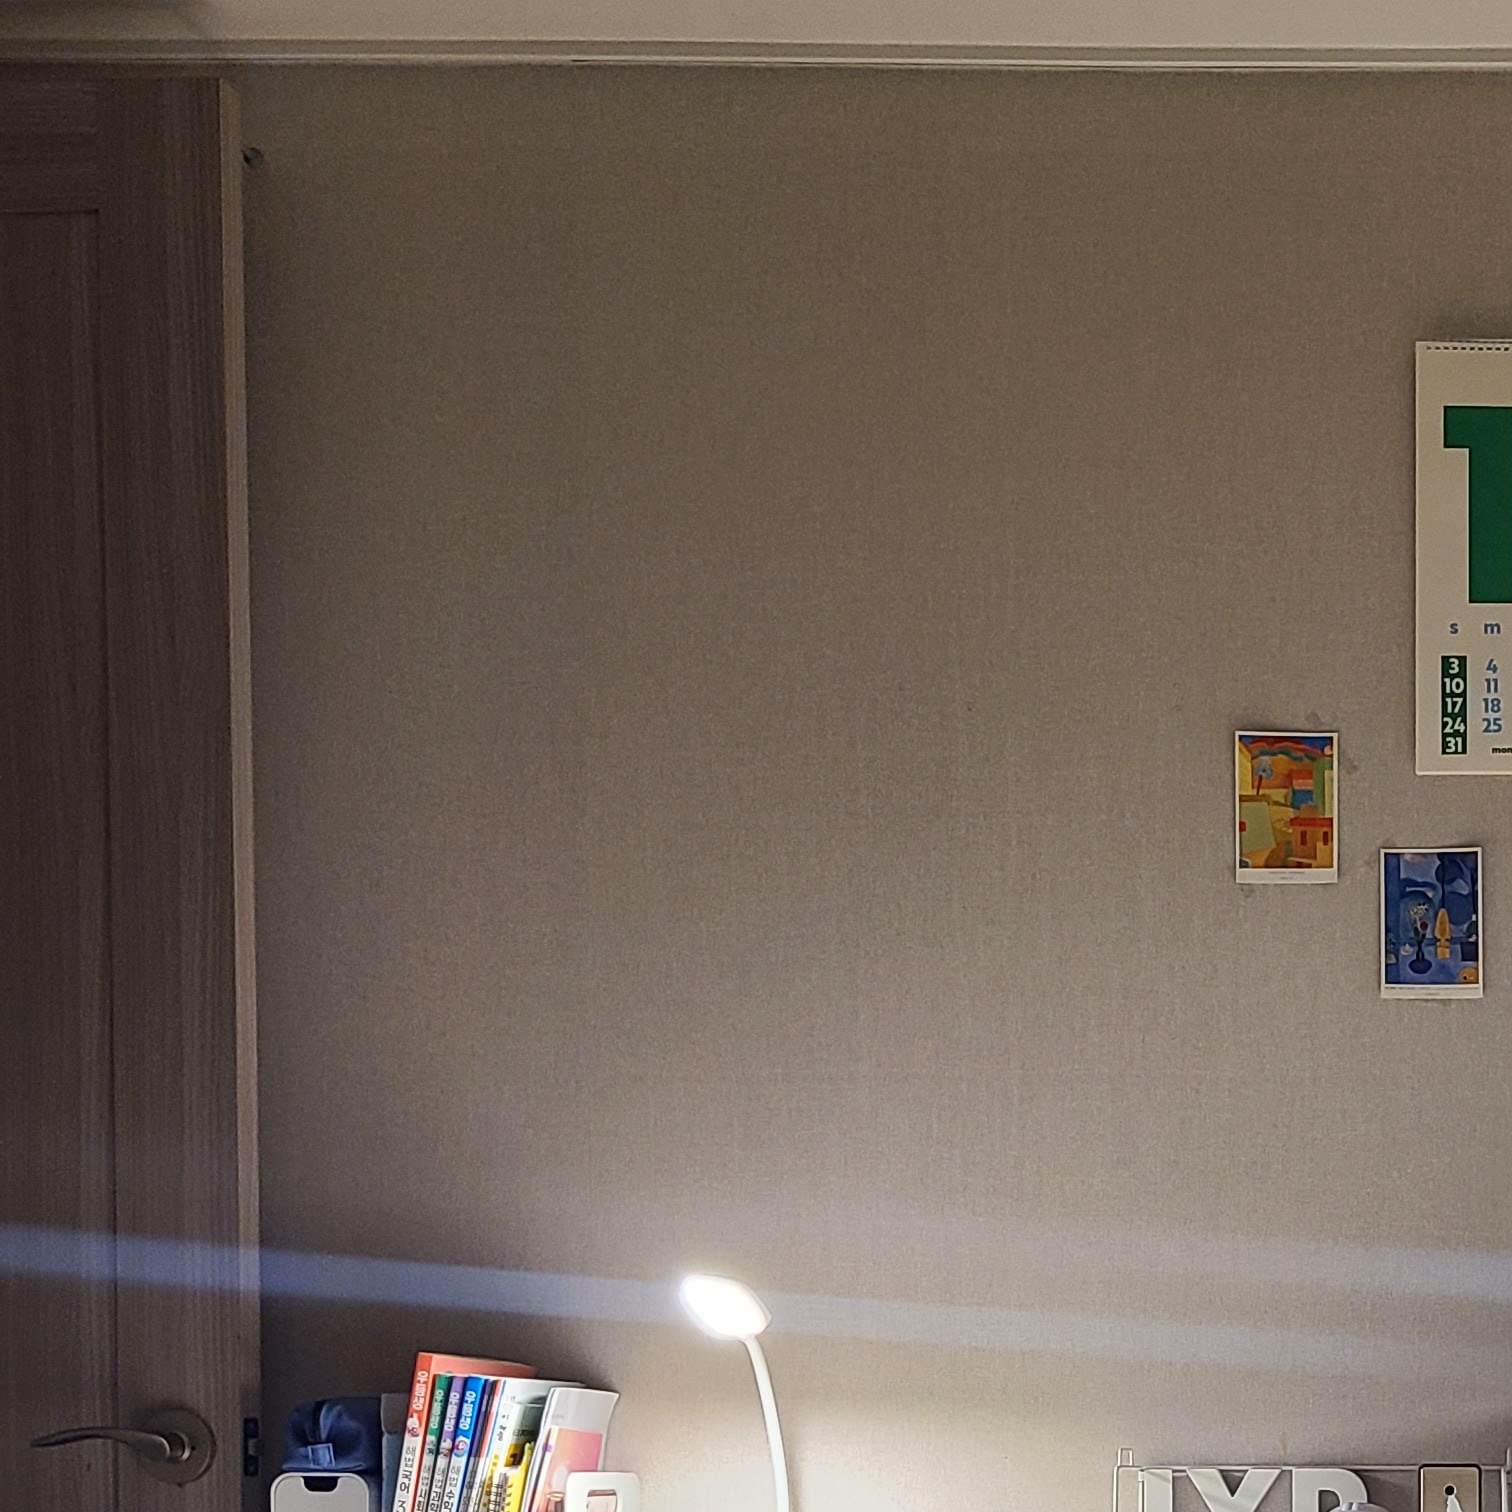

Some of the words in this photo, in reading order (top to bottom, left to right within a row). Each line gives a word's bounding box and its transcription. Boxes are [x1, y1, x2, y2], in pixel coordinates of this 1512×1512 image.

[1449, 623, 1458, 635] s
[1484, 623, 1501, 635] m
[1448, 658, 1460, 674] 3
[1486, 658, 1498, 674] 4
[1444, 677, 1464, 693] 10
[1485, 677, 1499, 693] 11
[1445, 697, 1463, 713] 17
[1483, 697, 1501, 713] 18
[1443, 717, 1465, 733] 24
[1482, 716, 1502, 733] 25
[1445, 737, 1463, 753] 31
